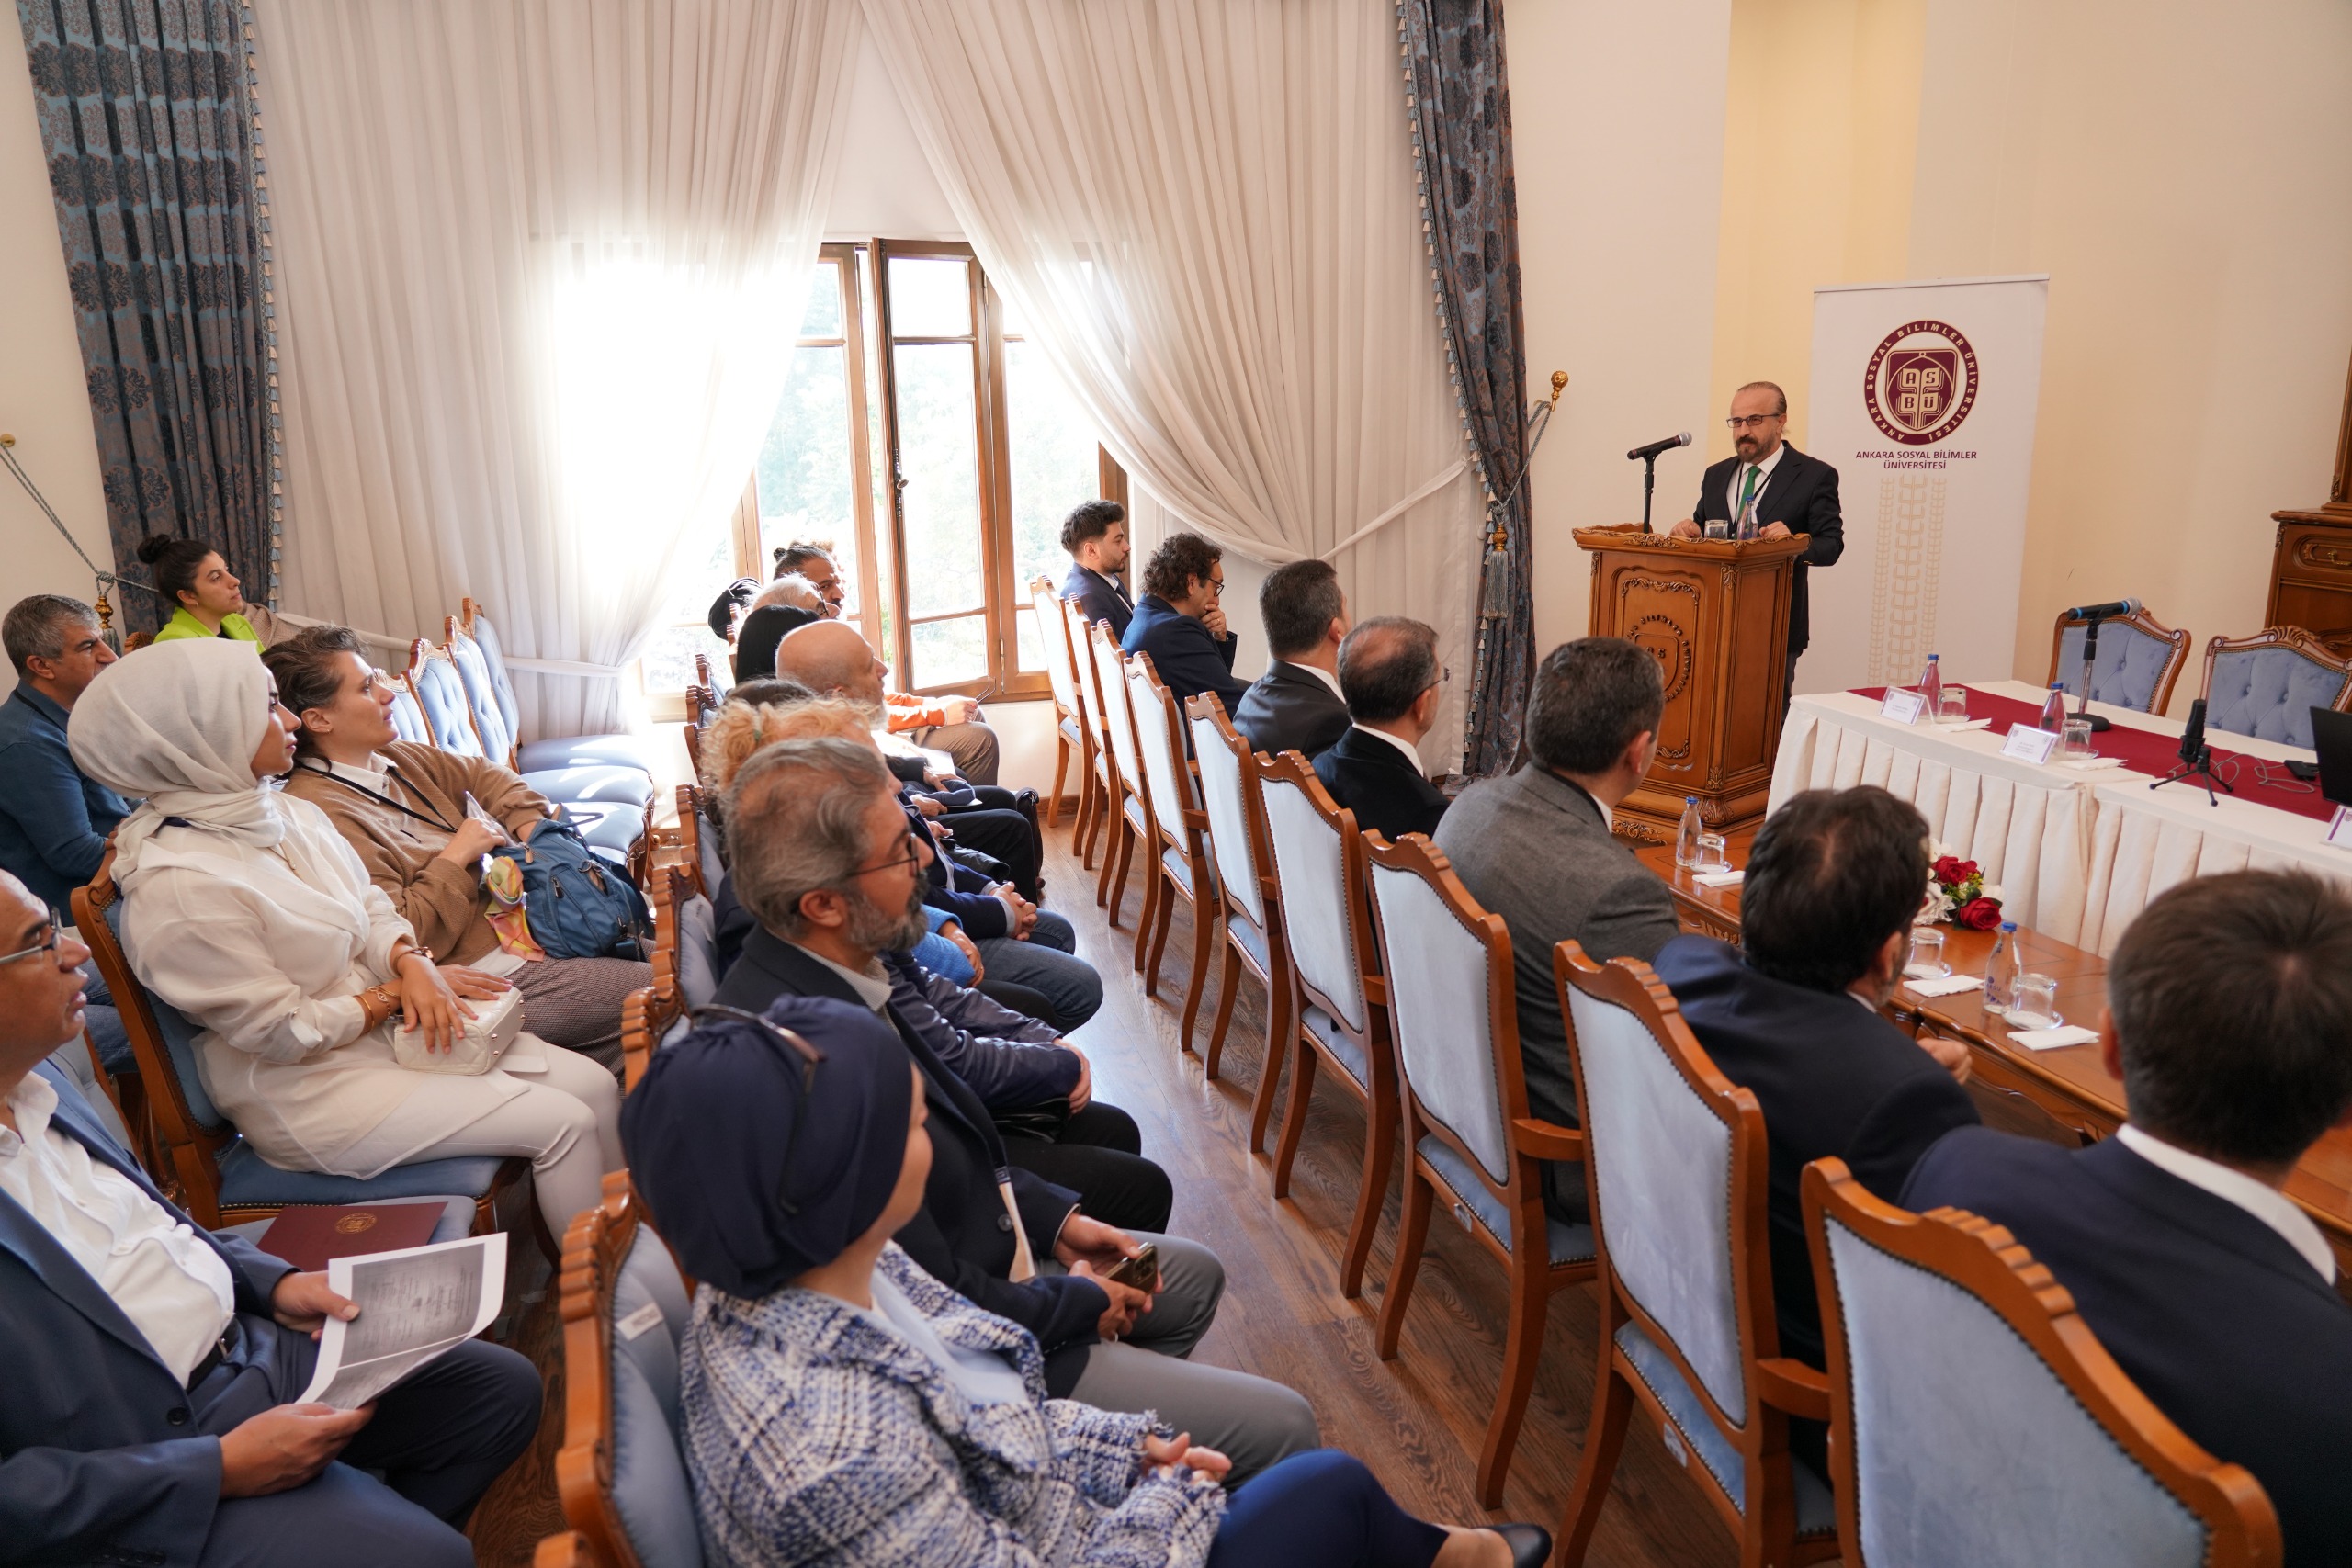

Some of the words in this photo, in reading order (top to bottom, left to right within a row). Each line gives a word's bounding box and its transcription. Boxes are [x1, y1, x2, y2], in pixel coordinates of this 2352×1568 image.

[1896, 321, 1964, 347] BİLİMLER
[1866, 341, 1892, 390] SOSYAL
[1928, 352, 1978, 442] ÜNİVERSİTESİ
[1868, 397, 1905, 441] ANKARA
[1855, 450, 1894, 459] ANKARA
[1896, 450, 1931, 459] SOSYAL
[1933, 449, 1977, 459] BİLİMLER
[1883, 459, 1946, 469] ÜNİVERSİTESİ
